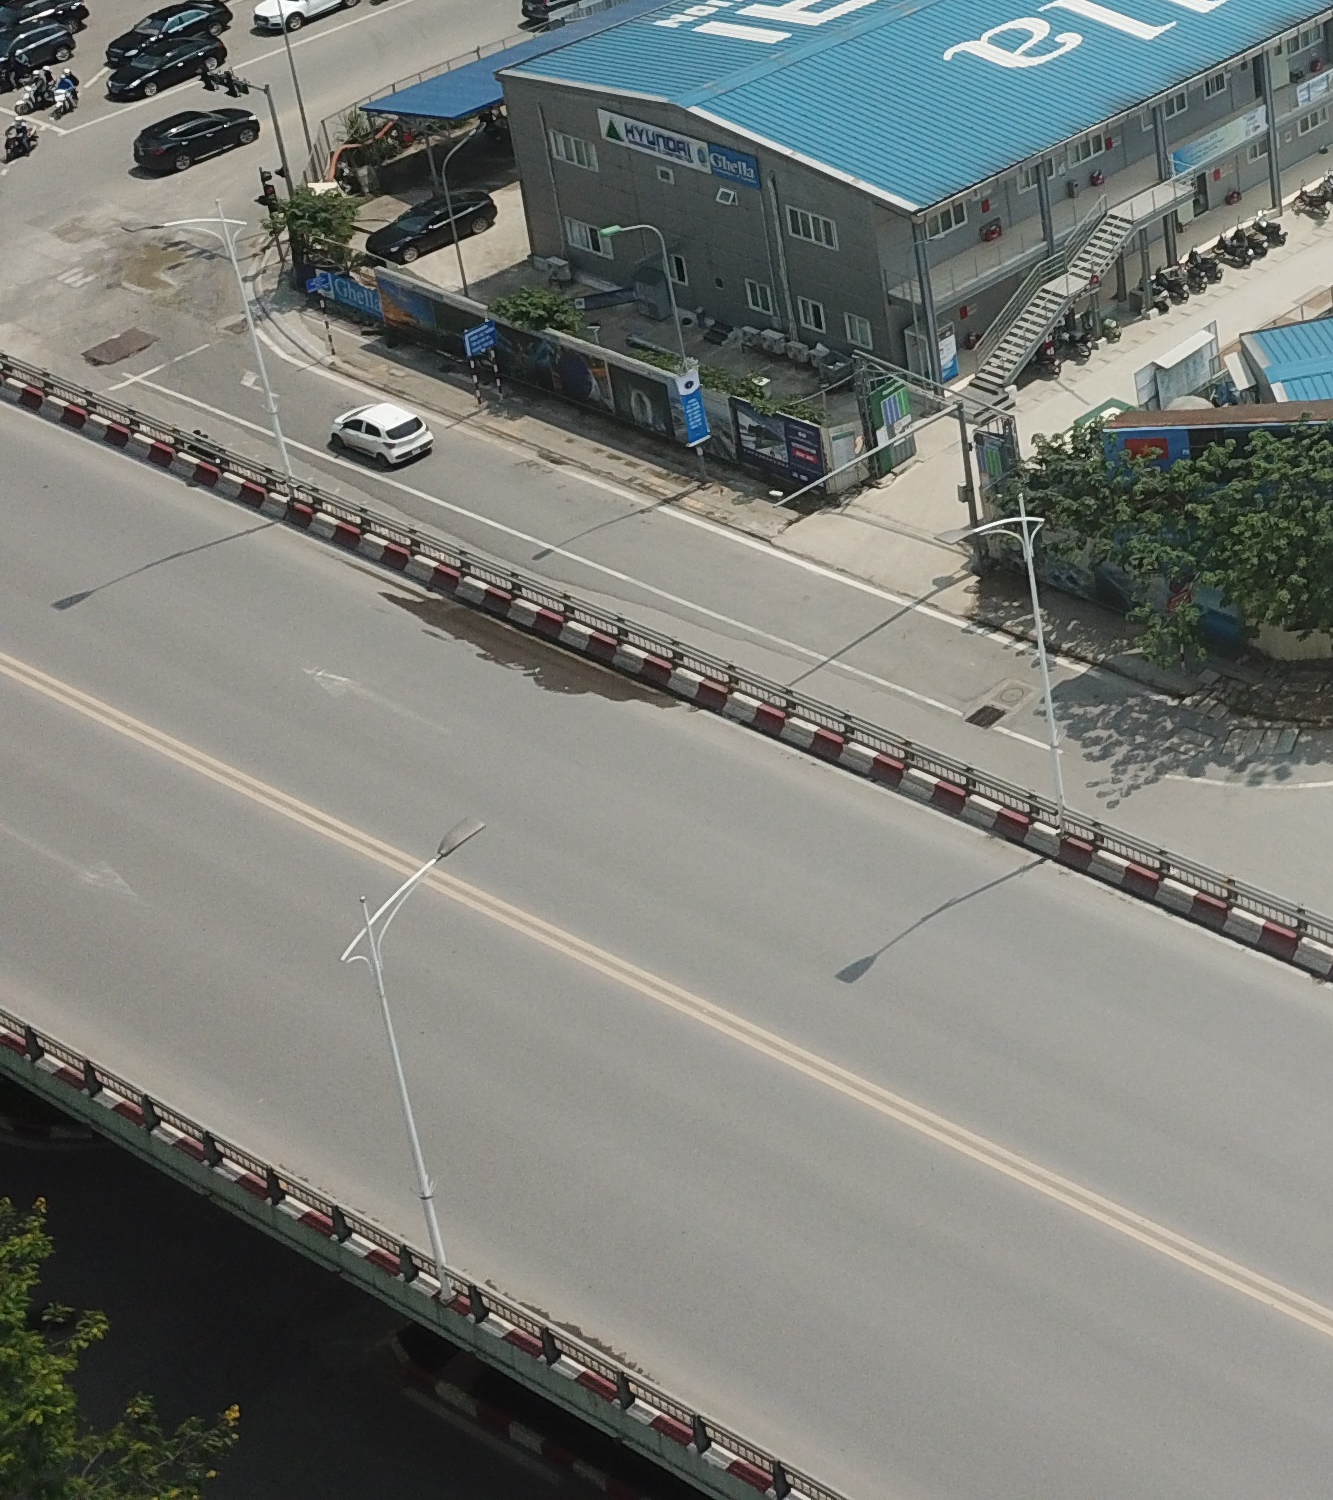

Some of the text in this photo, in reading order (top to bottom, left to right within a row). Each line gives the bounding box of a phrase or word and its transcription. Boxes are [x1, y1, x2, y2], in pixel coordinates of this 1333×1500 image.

[624, 122, 694, 163] HYUNDAI
[709, 152, 755, 179] Ghella
[333, 277, 381, 312] Ghella
